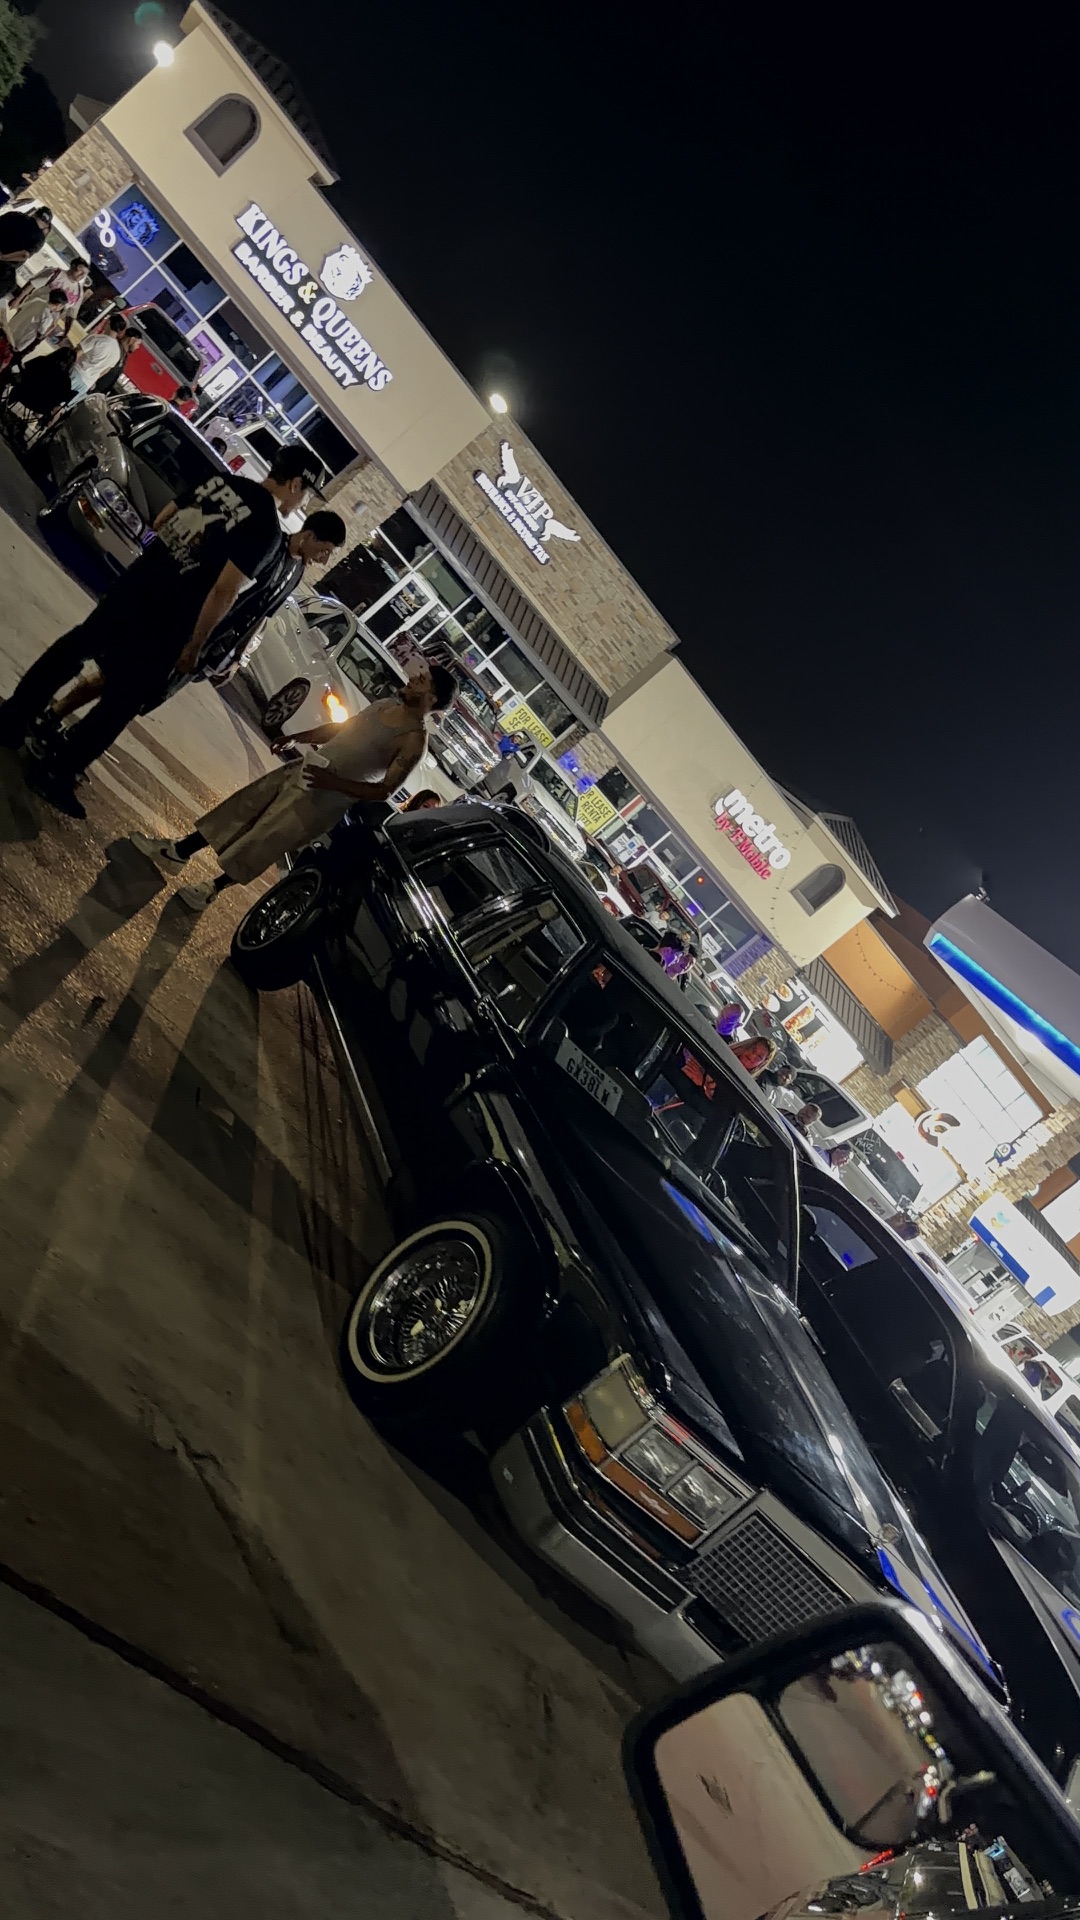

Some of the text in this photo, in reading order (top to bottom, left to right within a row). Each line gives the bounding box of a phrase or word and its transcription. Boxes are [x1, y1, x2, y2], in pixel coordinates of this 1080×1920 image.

[236, 203, 393, 391] KINGS & QUEENS
[233, 241, 358, 384] BARBER & BEAUTY
[517, 476, 555, 520] VIP
[532, 544, 549, 564] TAX
[508, 716, 521, 729] SE
[515, 707, 531, 724] FOR
[526, 721, 549, 745] LEASE
[580, 801, 602, 823] RENTA
[590, 795, 611, 818] LEASE
[715, 811, 732, 831] by
[715, 789, 790, 869] metro
[581, 1055, 605, 1081] TEXAS
